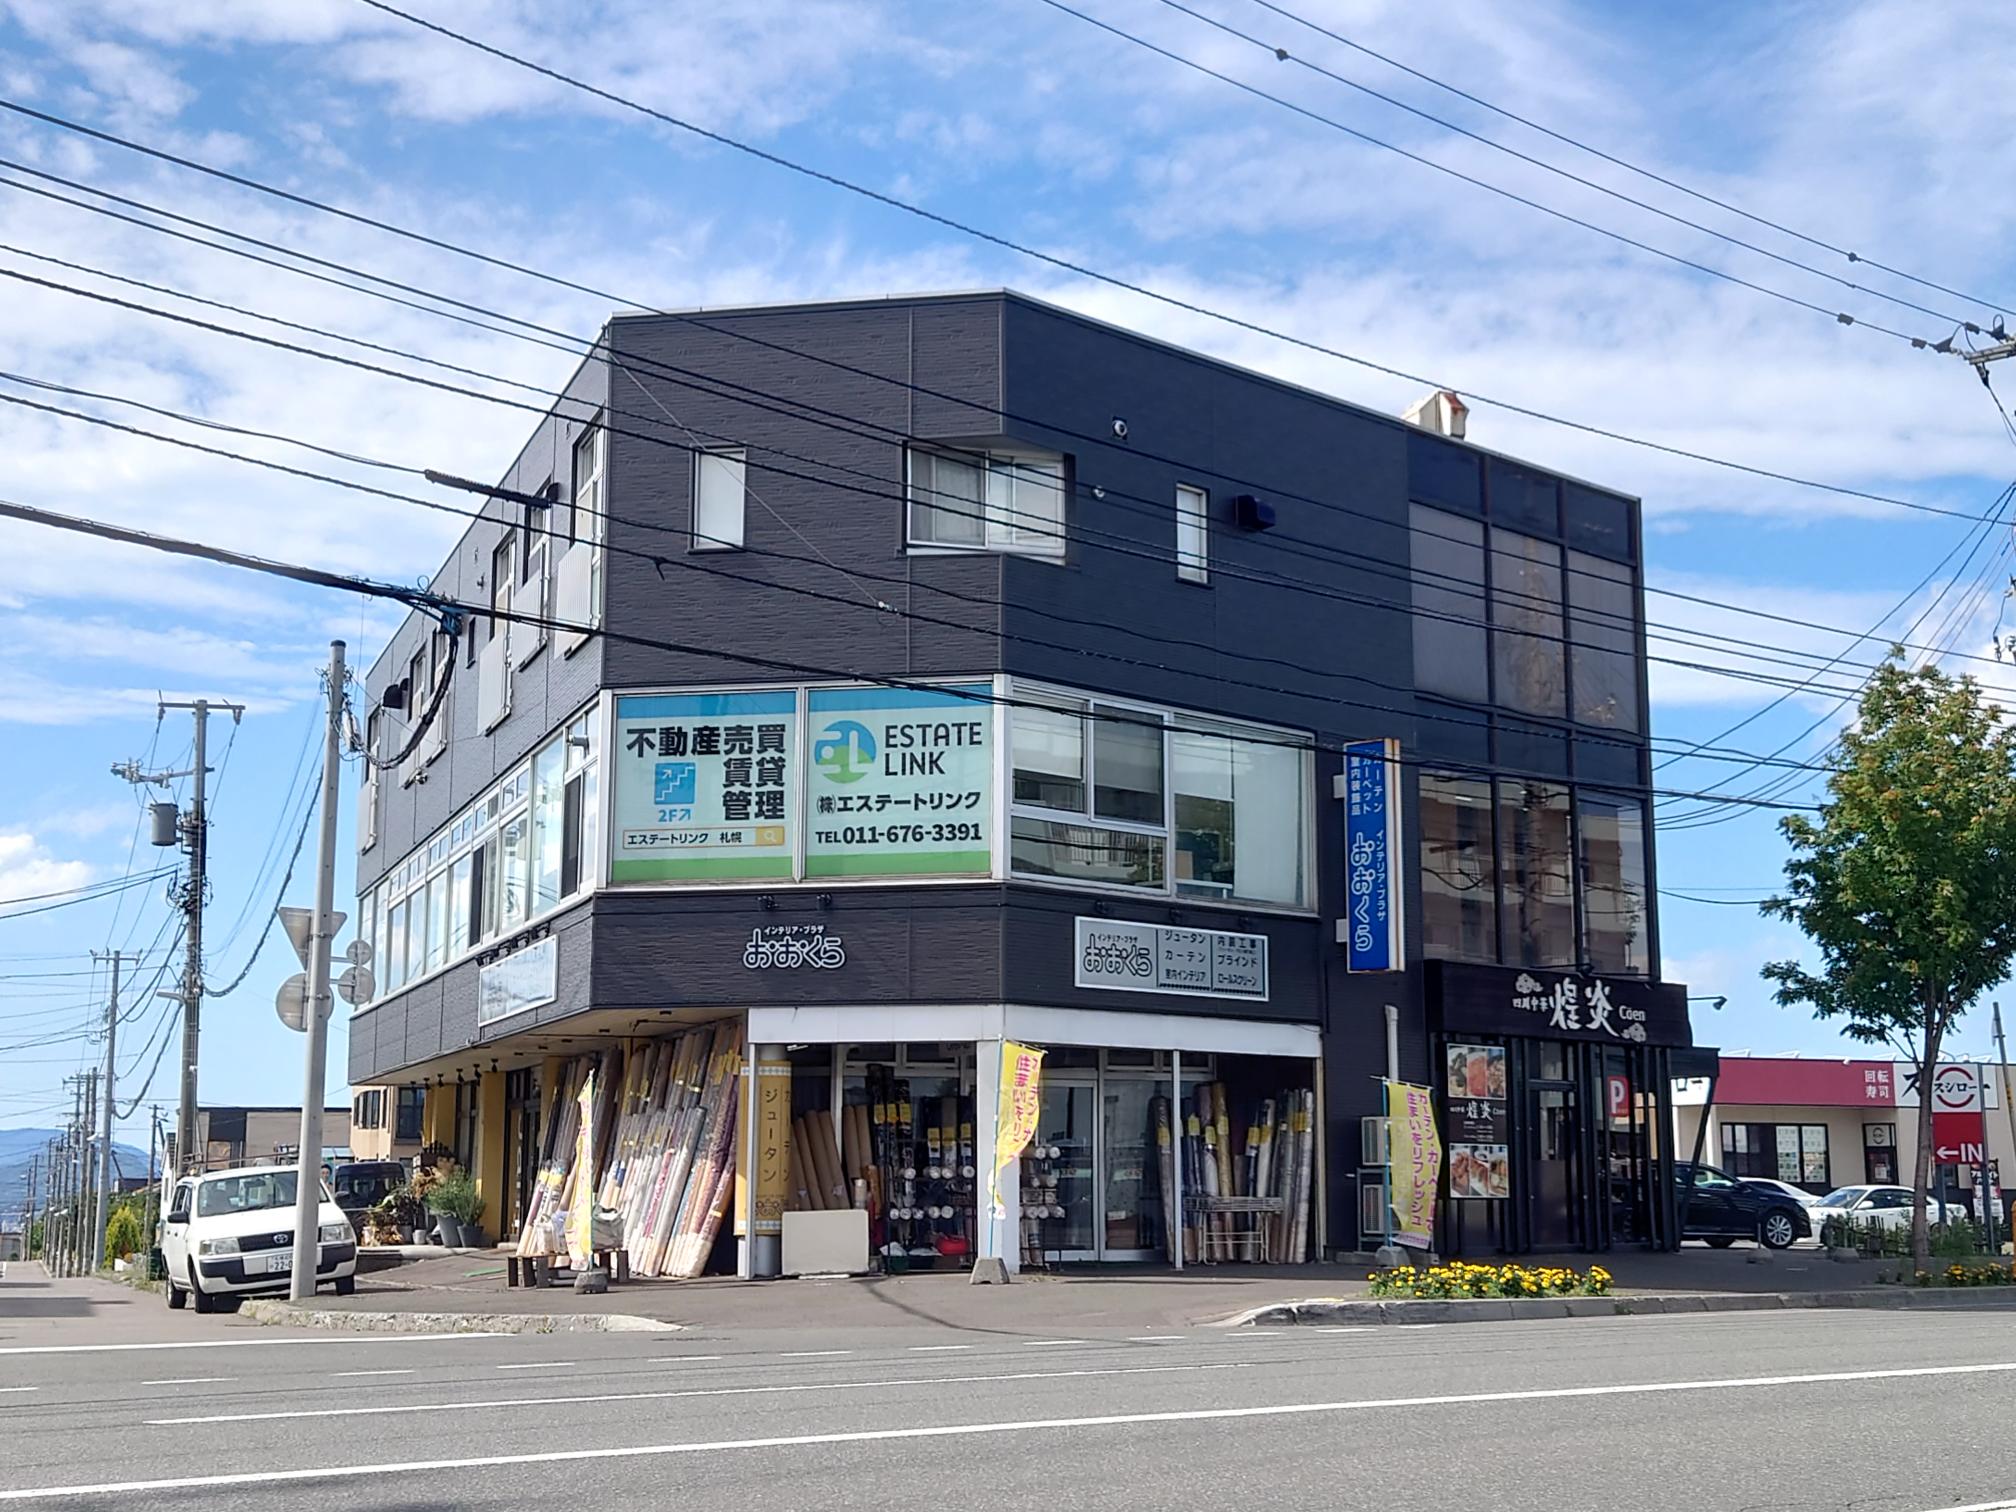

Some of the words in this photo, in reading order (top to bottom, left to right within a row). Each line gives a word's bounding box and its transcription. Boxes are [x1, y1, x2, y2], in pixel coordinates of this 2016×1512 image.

[626, 724, 786, 757] 不動産売買
[885, 722, 982, 748] ESTATE
[722, 756, 786, 788] 賃貸
[885, 751, 946, 776] LINK
[658, 808, 678, 822] 2F
[721, 789, 786, 821] 管理
[627, 832, 709, 845] エステートリンク
[719, 831, 742, 844] 札幌
[1351, 832, 1375, 952] おおくら
[764, 924, 824, 935] インテリア・プラザ
[1165, 931, 1206, 944] ジュータン
[743, 928, 845, 968] おおくら
[1083, 933, 1152, 977] おおくら
[1165, 950, 1206, 963] カーテン
[1218, 954, 1257, 968] ブラインド
[1864, 1070, 1889, 1083] 回転
[1933, 1082, 1978, 1093] スシロー
[1610, 1080, 1625, 1114] P
[1865, 1085, 1889, 1098] 寿司
[764, 1089, 778, 1182] ジュータン
[1960, 1143, 1983, 1162] IN
